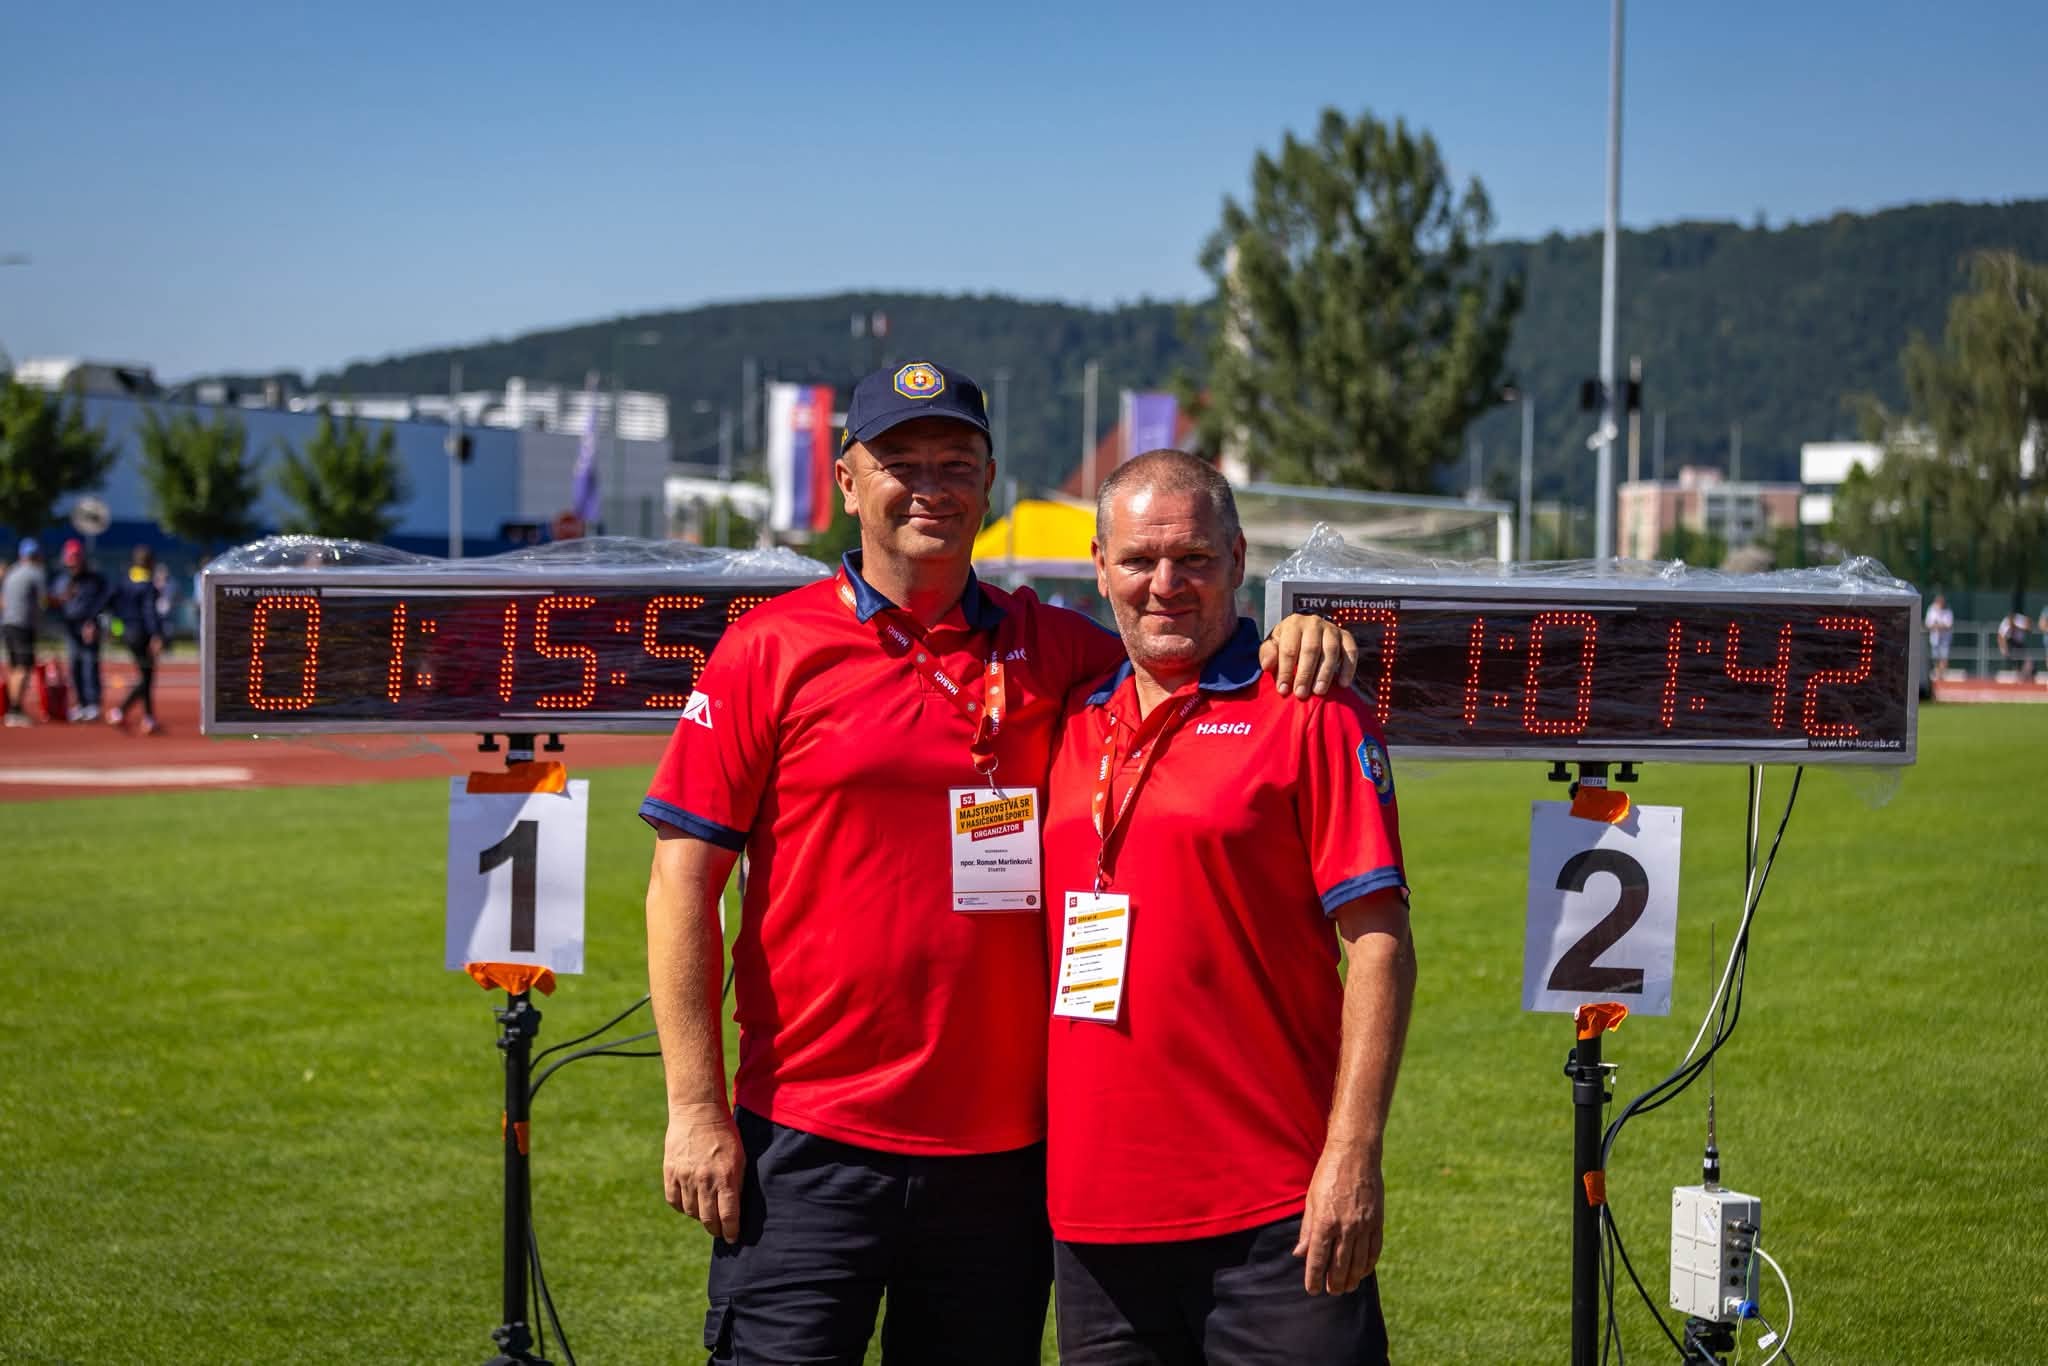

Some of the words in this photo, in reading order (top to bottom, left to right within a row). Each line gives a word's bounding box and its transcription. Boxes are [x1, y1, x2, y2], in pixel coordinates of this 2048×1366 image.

[223, 587, 250, 597] TRV
[1300, 598, 1328, 609] TRV
[1331, 599, 1397, 610] elektronik
[247, 596, 772, 711] 01:15:5
[1196, 721, 1252, 736] HASIČI
[959, 797, 1019, 820] MAJSTROVSTVÁ
[1019, 798, 1030, 808] SR
[966, 813, 1004, 829] HASIČSKOM
[1005, 808, 1030, 821] ŠPORTE
[974, 823, 1020, 838] ORGANIZÁTOR
[976, 858, 998, 866] Roman
[479, 820, 539, 952] 1
[1547, 848, 1649, 994] 2
